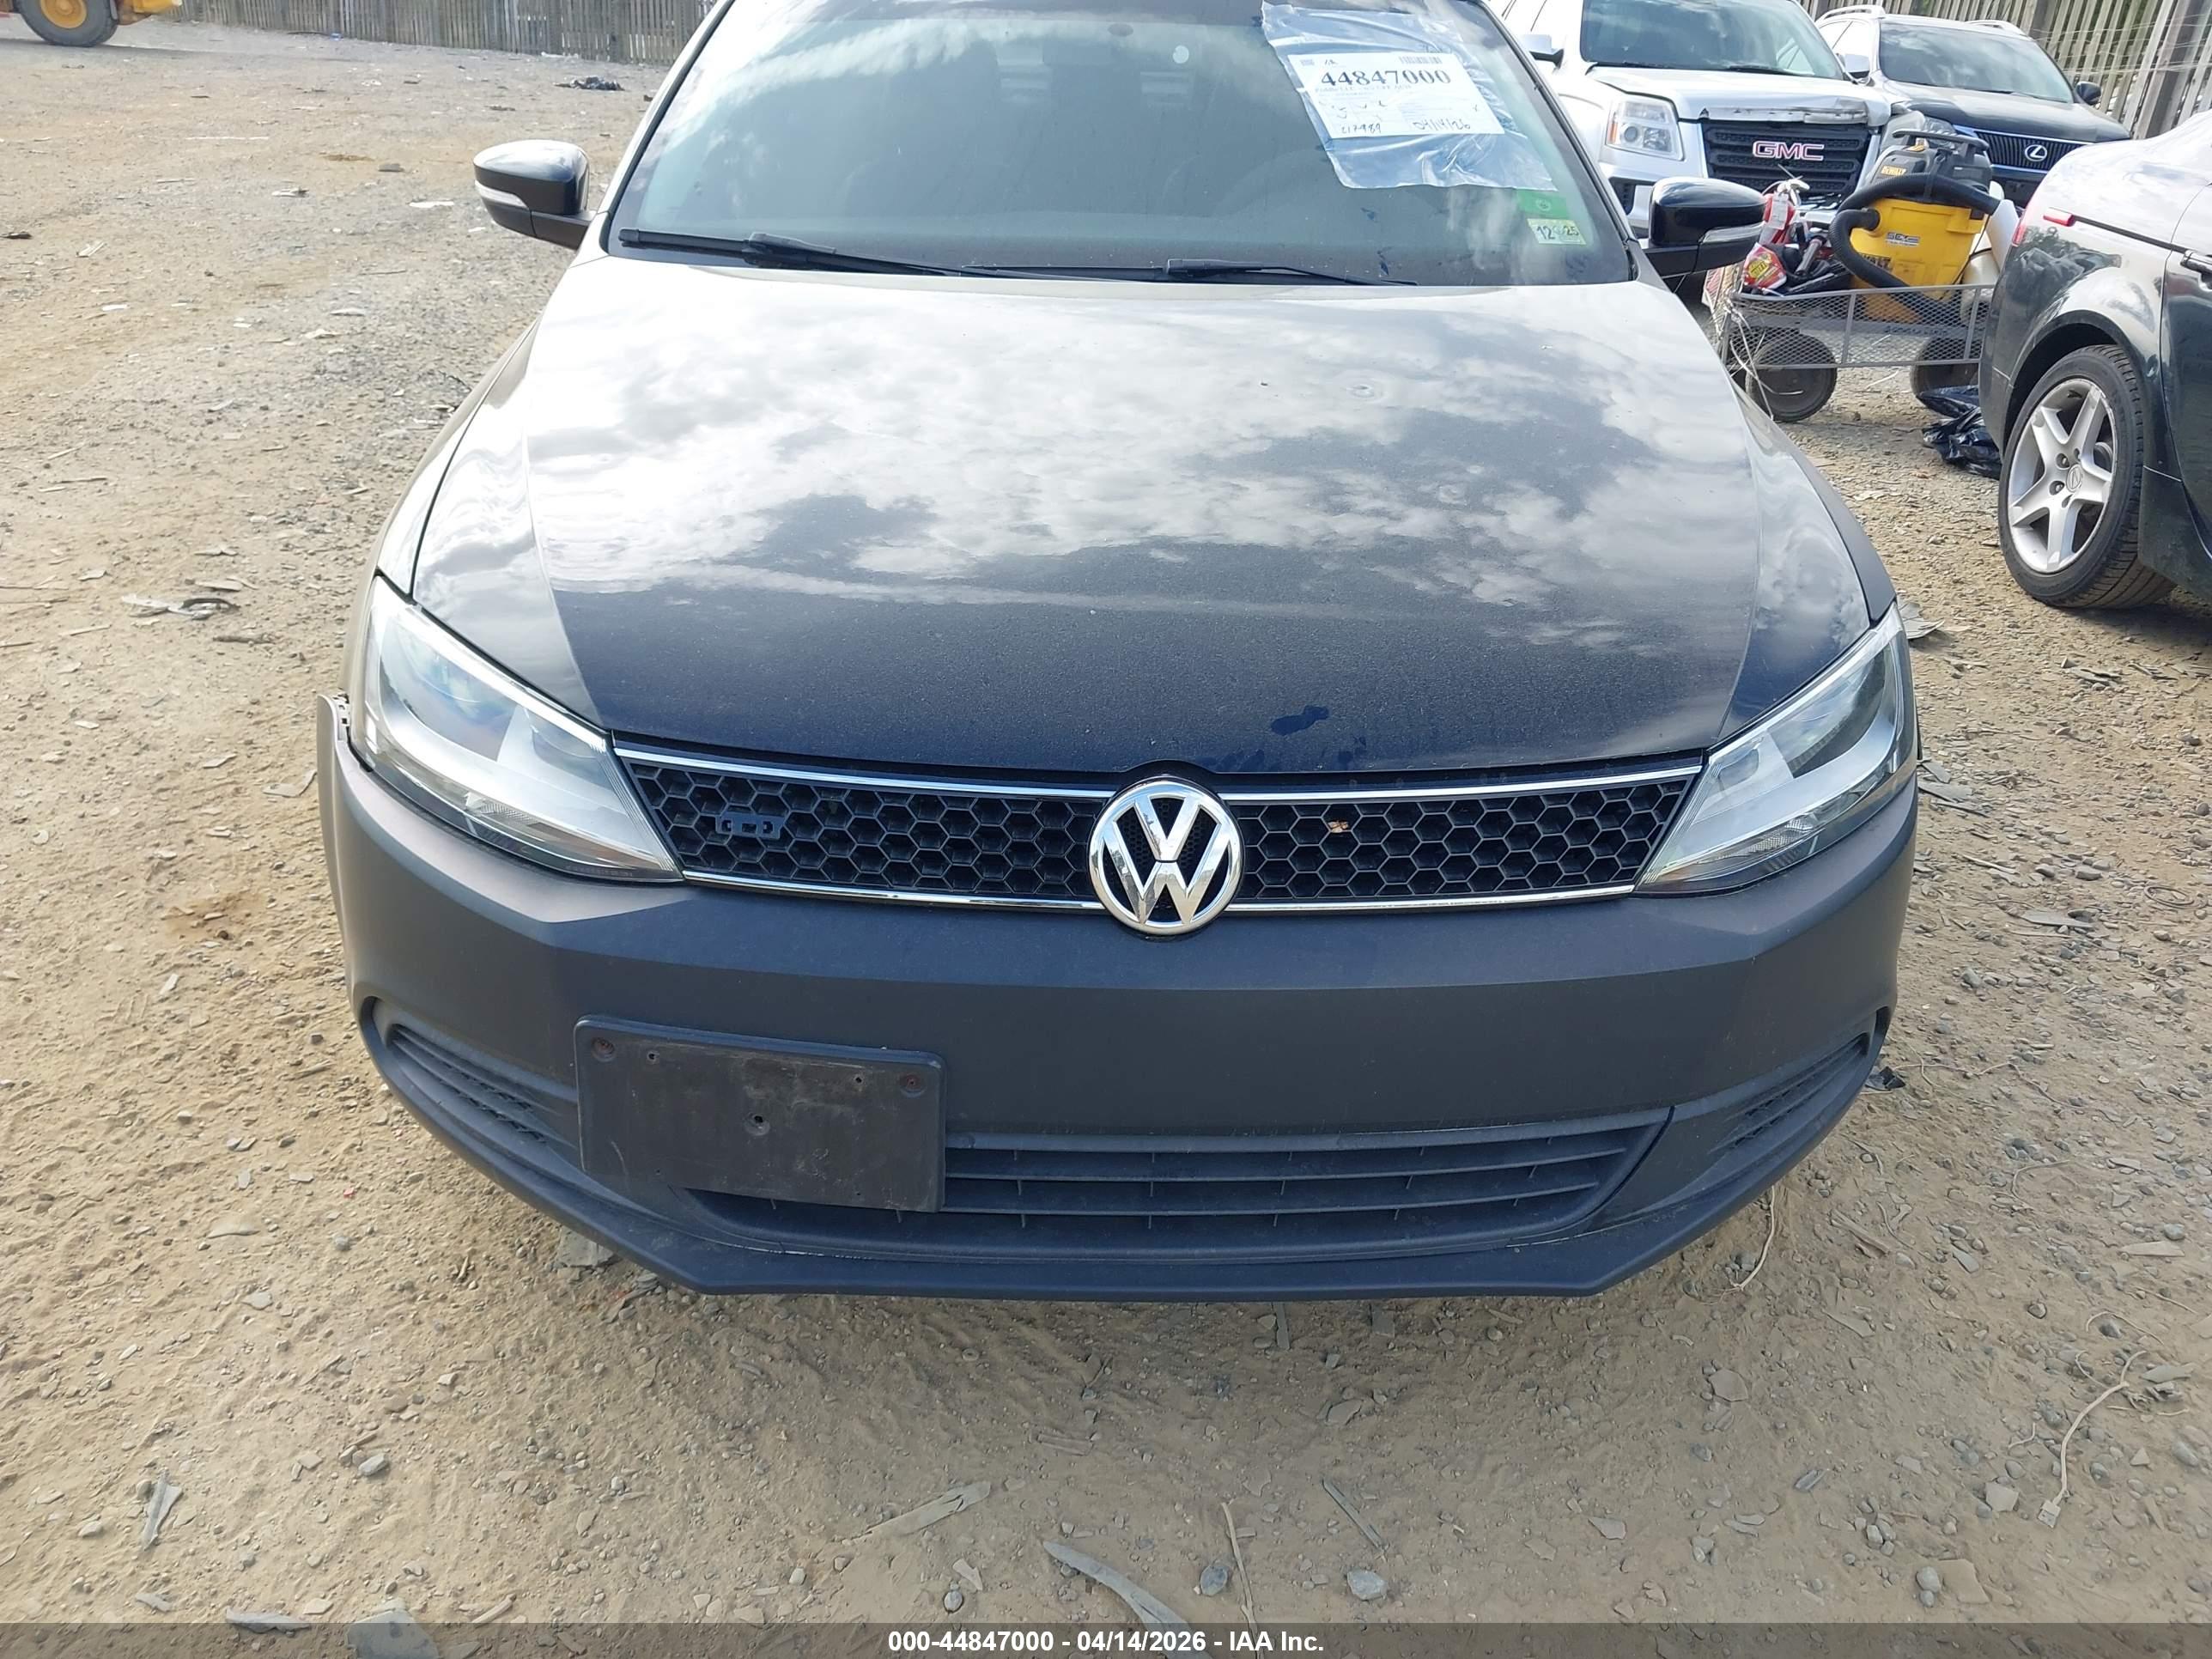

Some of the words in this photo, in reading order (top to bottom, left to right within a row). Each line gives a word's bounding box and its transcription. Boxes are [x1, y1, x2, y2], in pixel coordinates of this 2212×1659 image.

[1321, 70, 1451, 86] 44847000
[1753, 140, 1825, 161] GMC
[1537, 225, 1556, 240] 12
[1090, 781, 1242, 935] VW
